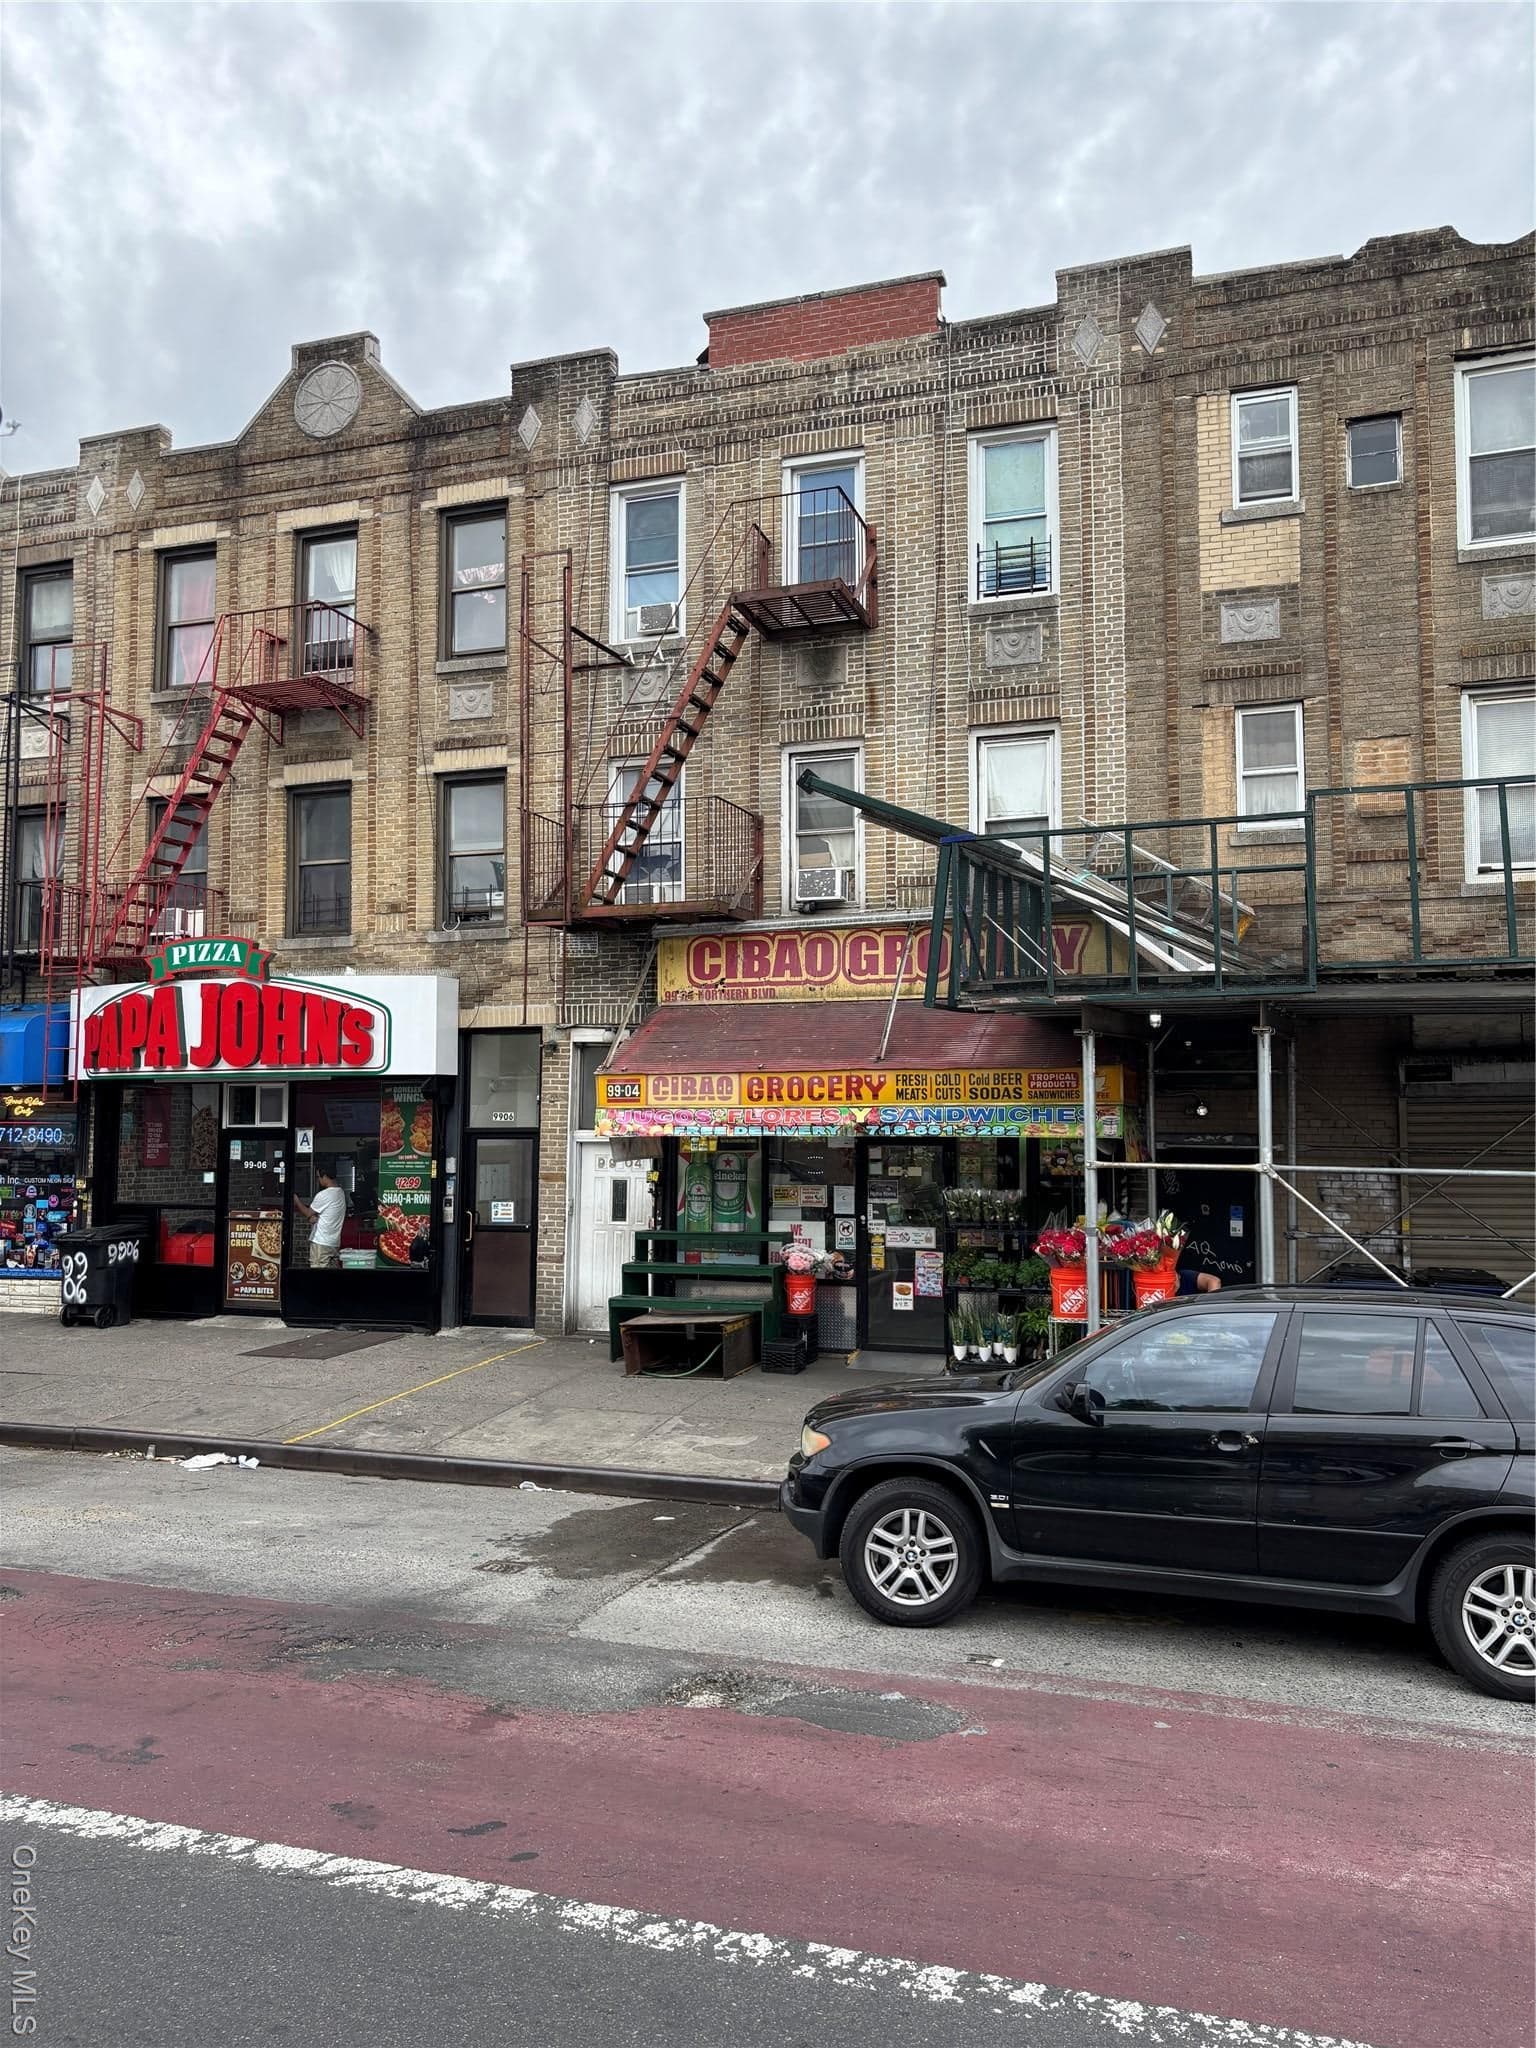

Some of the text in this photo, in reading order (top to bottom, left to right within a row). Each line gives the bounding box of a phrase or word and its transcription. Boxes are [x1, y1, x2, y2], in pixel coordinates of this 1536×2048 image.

[171, 942, 242, 966] PIZZA
[690, 933, 837, 982] CIBAO
[83, 985, 185, 1069] PAPA
[895, 1073, 928, 1087] FRESH
[935, 1072, 961, 1086] COLD
[968, 1072, 1022, 1086] Cold BEER
[1030, 1073, 1077, 1081] TROPICAL
[607, 1084, 640, 1098] 99-04
[652, 1074, 887, 1102] CIBAO GROCERY
[1030, 1081, 1078, 1089] PRODUCTS
[896, 1088, 928, 1101] MEATS
[935, 1088, 961, 1100] CUTS
[968, 1087, 1023, 1100] SODAS
[1027, 1089, 1081, 1100] SANDWICHES
[493, 1112, 514, 1121] 9906
[615, 1109, 711, 1125] JUGOS
[727, 1108, 843, 1124] FLORES
[850, 1107, 873, 1123] Y
[673, 1126, 728, 1136] FREE
[732, 1126, 842, 1136] DELIVERY
[300, 1133, 310, 1146] A
[243, 1161, 268, 1169] 99-06
[62, 1251, 88, 1279] 99
[63, 1275, 87, 1303] 06
[240, 1286, 257, 1294] PAPA
